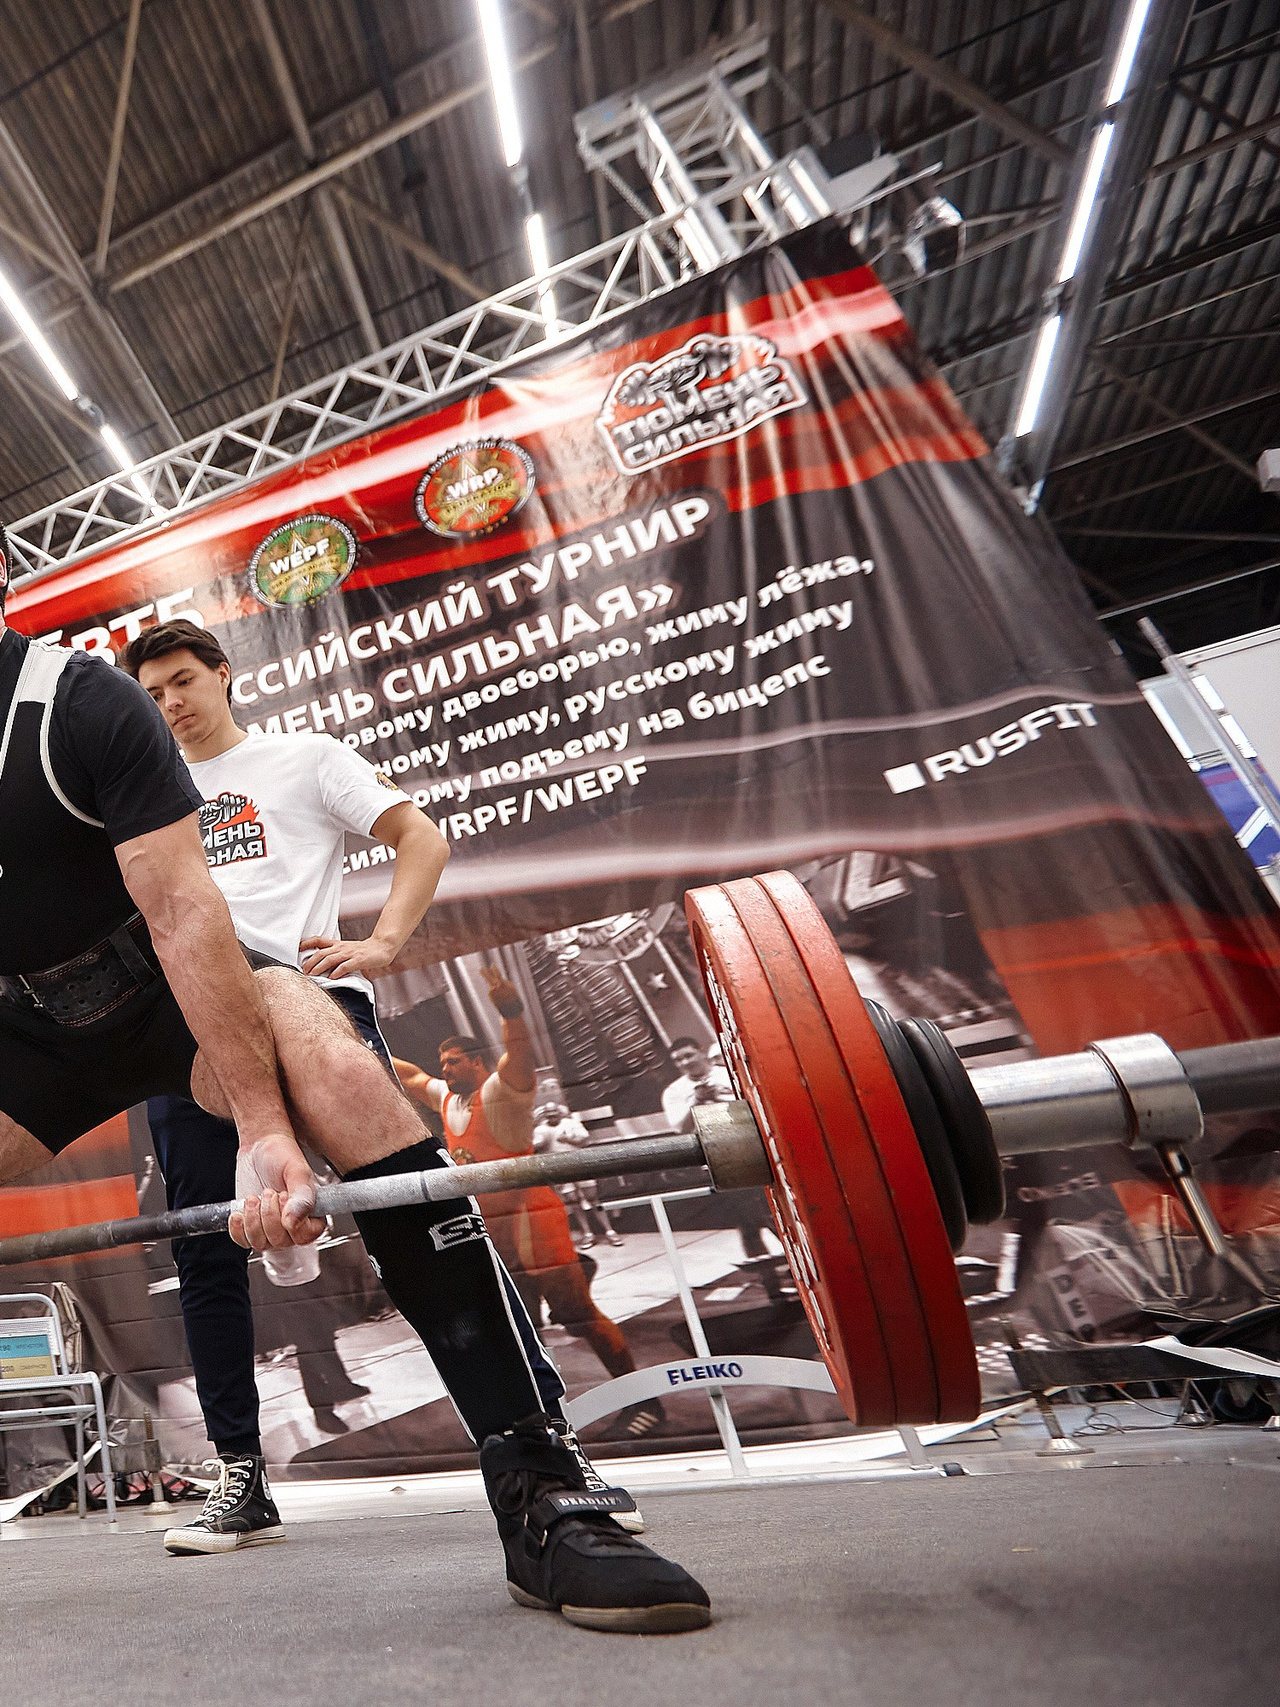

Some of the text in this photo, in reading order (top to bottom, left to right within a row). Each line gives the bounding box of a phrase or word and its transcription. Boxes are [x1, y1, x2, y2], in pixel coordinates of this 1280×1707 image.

[612, 365, 782, 443] ТЮМЕНЬ
[622, 381, 796, 467] СИЛЬНАЯ
[269, 537, 330, 575] WEPF
[486, 497, 710, 606] ТУРНИР
[341, 555, 875, 750] овому двоеборью, жиму лёжа,
[382, 583, 675, 703] СИЛЬНАЯ»
[458, 706, 560, 753] жиму,
[563, 645, 735, 723] русскому
[742, 600, 853, 659] жиму
[480, 722, 629, 788] подъему
[636, 706, 685, 737] на
[687, 654, 832, 721] бицепс
[923, 702, 1099, 782] RUSFIT
[666, 1362, 744, 1386] ELEIKO
